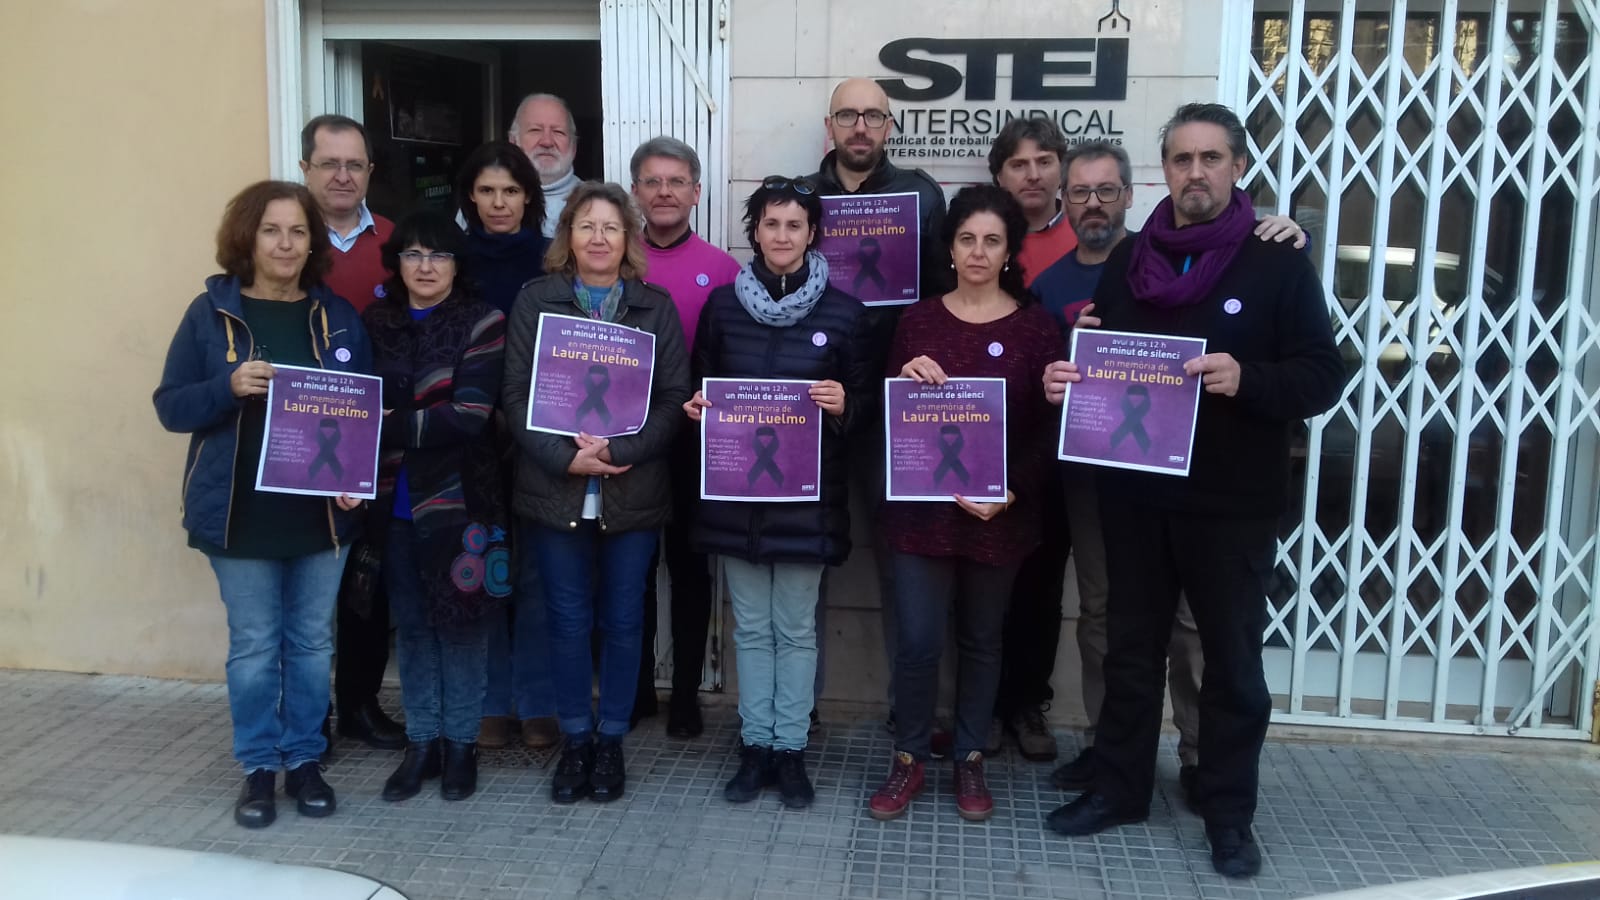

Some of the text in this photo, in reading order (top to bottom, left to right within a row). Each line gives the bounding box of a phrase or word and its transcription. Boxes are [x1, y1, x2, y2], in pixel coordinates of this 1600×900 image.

[874, 37, 1129, 101] STEI
[889, 108, 1124, 135] NTERSICAL
[885, 136, 927, 145] ndicat
[930, 136, 945, 145] de
[886, 148, 985, 158] TERSINDICAL
[875, 206, 900, 214] silenci
[824, 226, 905, 237] Laura Luelmo
[573, 331, 596, 340] minut
[610, 335, 636, 345] silenci
[553, 346, 639, 367] Laura Luelmo
[1110, 347, 1135, 356] minut
[1138, 349, 1149, 357] de
[1150, 350, 1180, 360] silenci
[1105, 359, 1115, 367] en
[1087, 365, 1183, 386] Laura Luelmo
[303, 382, 327, 391] minut
[328, 384, 339, 392] de
[340, 386, 366, 395] silenci
[774, 393, 800, 401] silenci
[920, 391, 944, 399] minut
[945, 391, 955, 399] de
[957, 391, 984, 399] silenci
[284, 400, 368, 419] Laura Luelmo
[782, 404, 792, 413] de
[719, 412, 806, 425] Laura Luelmo
[903, 411, 990, 423] Laura Luelmo
